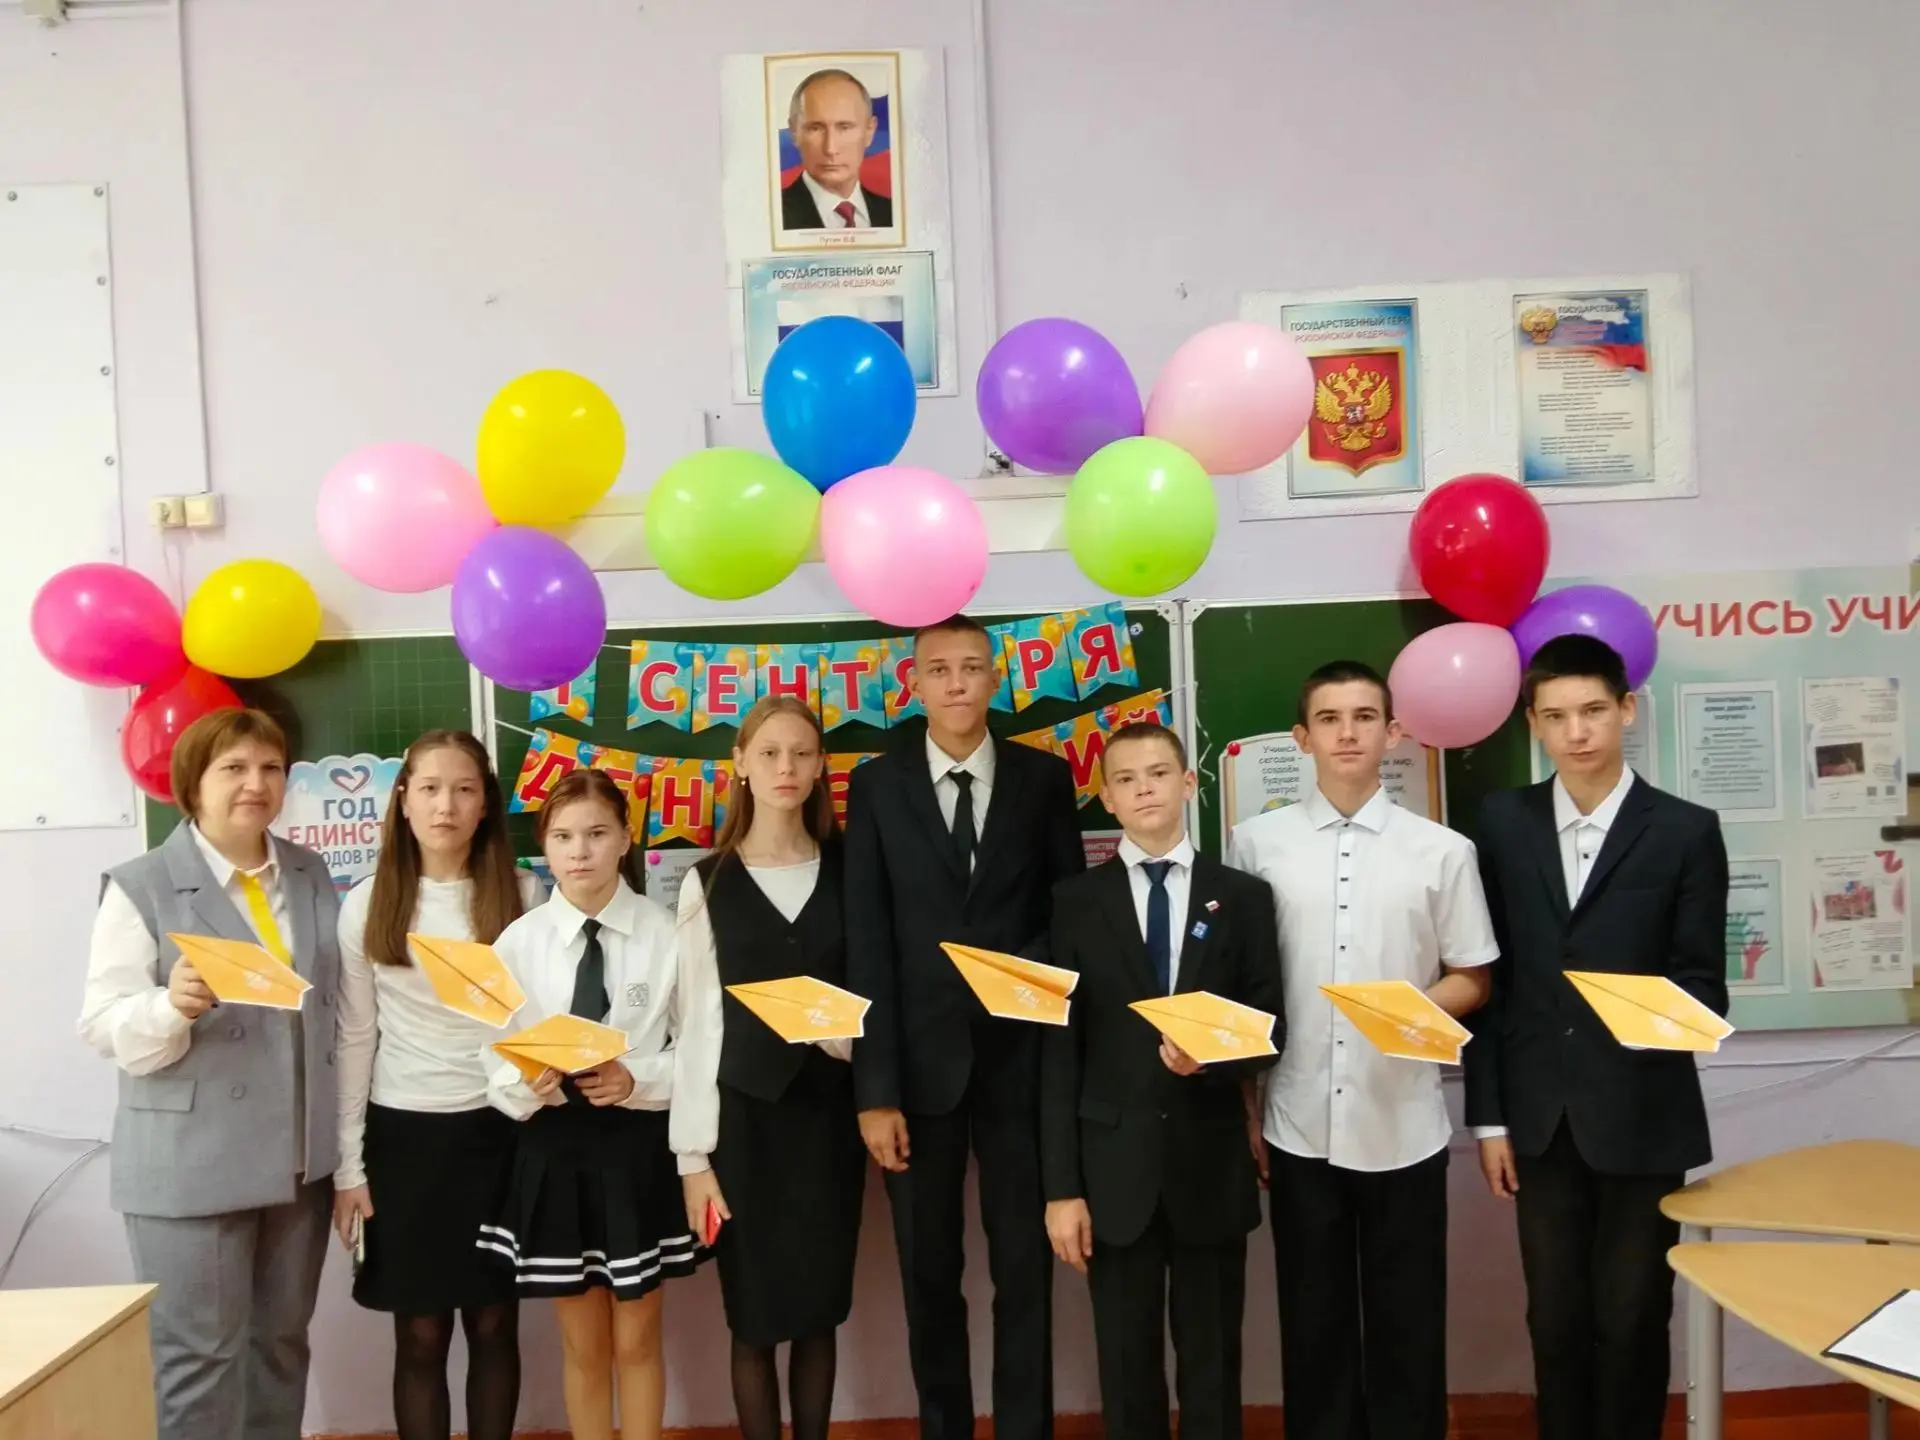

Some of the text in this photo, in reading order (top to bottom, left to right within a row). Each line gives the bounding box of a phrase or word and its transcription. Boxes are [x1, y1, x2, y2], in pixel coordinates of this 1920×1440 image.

[772, 264, 904, 280] ГОСУДАРСТВЕННЫЙ ФЛАГ
[781, 277, 896, 290] РОССИЙСКОЙ ФЕДЕРАЦИИ
[1290, 315, 1386, 331] ГОСУДАРСТВЕННЫЙ
[1826, 595, 1920, 633] УЧИ
[638, 622, 1122, 714] СЕНТЯРЯ
[1258, 756, 1296, 765] сегодня
[323, 797, 378, 821] ГОД
